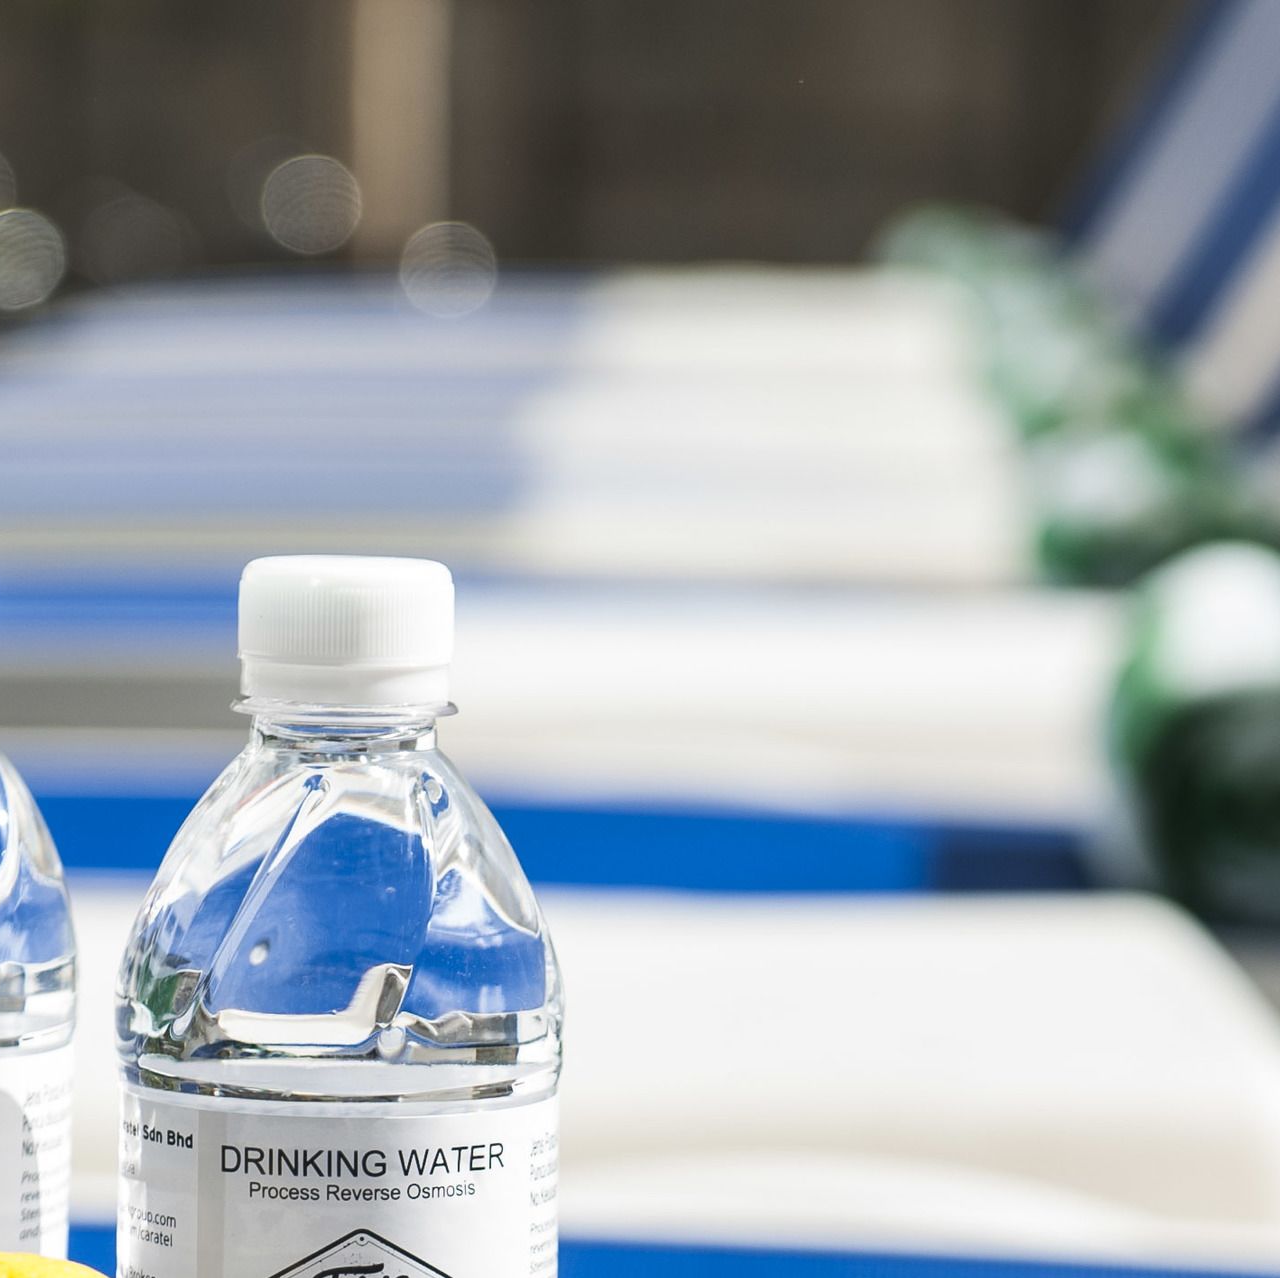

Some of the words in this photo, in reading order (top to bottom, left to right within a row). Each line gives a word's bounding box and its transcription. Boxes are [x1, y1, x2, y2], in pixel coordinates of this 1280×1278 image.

[142, 1124, 163, 1144] Sdn
[167, 1130, 193, 1149] Bhd
[221, 1145, 387, 1178] DRINKING
[398, 1143, 504, 1174] WATER
[249, 1181, 320, 1201] Process
[326, 1183, 401, 1202] Reverse
[406, 1180, 476, 1200] Osmosis
